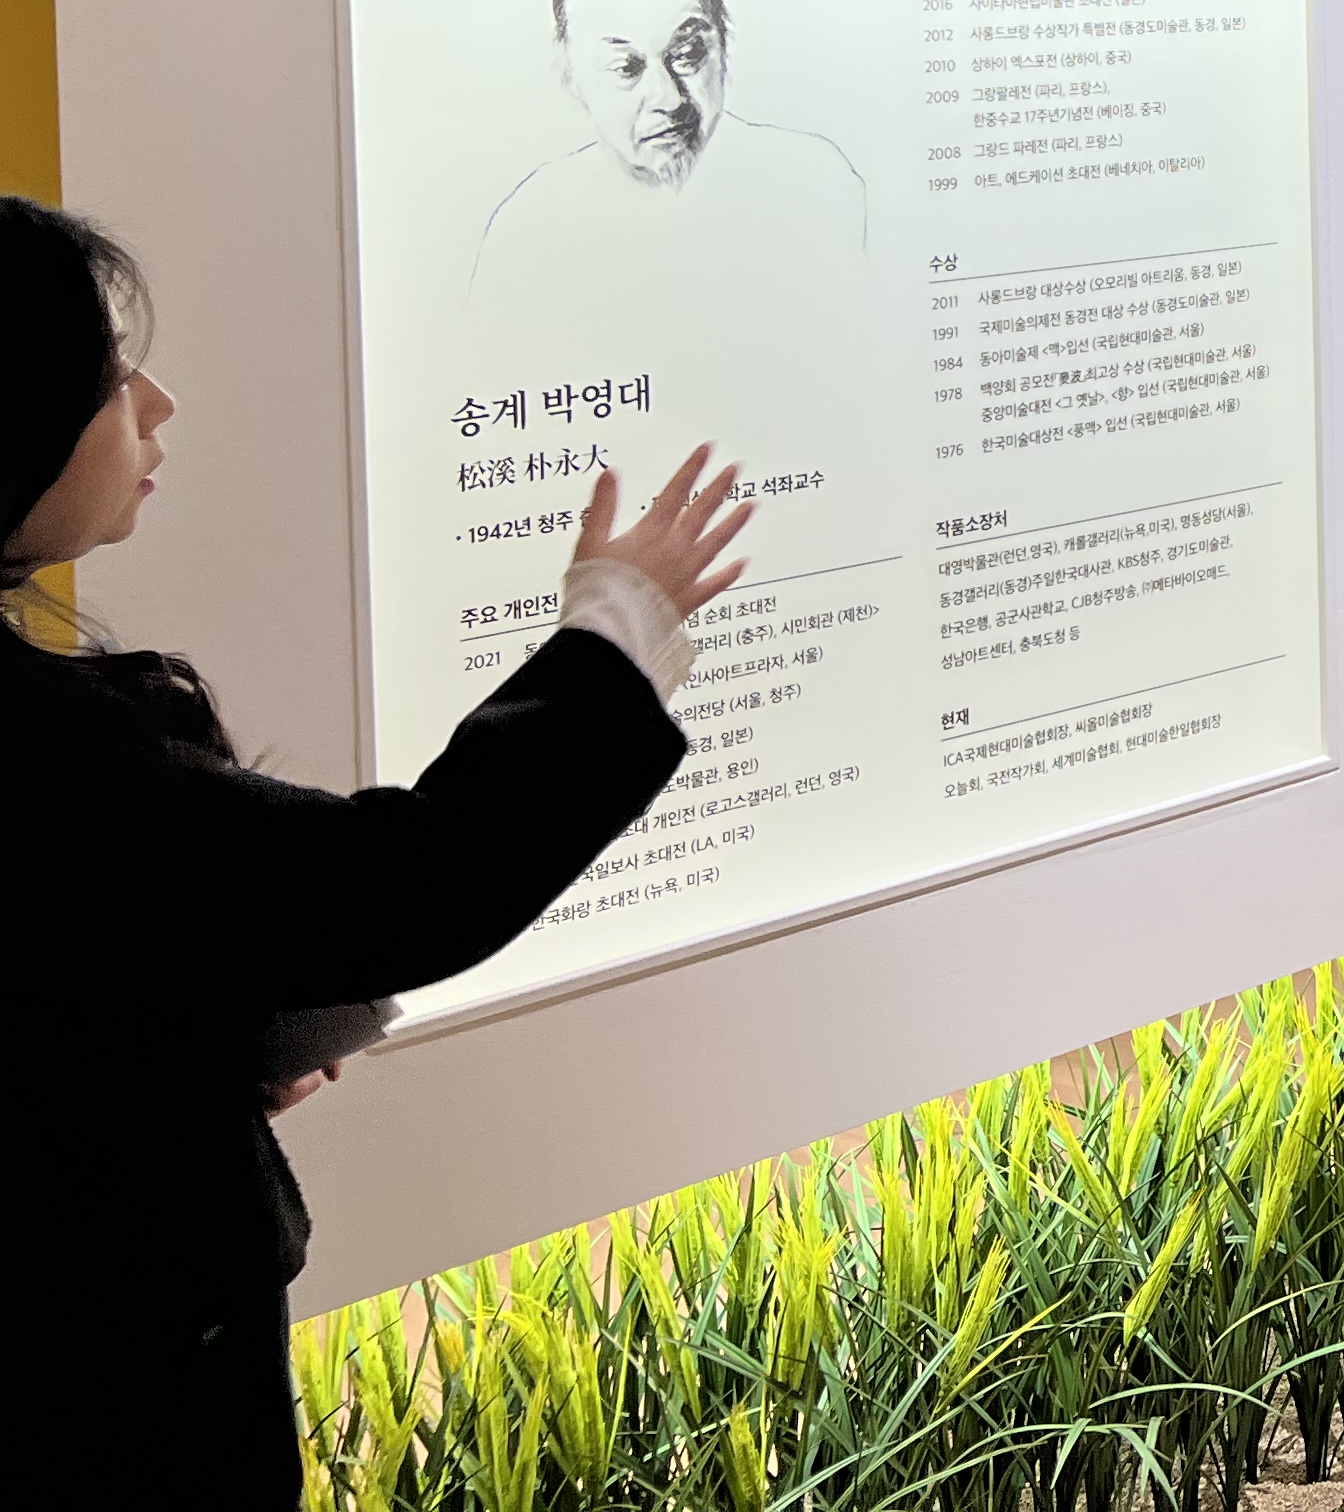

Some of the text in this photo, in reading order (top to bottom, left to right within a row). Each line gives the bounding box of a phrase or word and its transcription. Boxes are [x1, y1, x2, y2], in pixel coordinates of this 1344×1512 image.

[924, 29, 953, 42] 2012
[1033, 23, 1079, 39] 수상작가
[1082, 22, 1116, 36] 특별전
[925, 59, 955, 73] 2010
[971, 56, 1007, 72] 상하이
[1011, 53, 1057, 70] 엑스포전
[926, 90, 959, 104] 2009
[974, 112, 1021, 128] 한중수교
[1025, 106, 1093, 124] 17주년기념전
[928, 146, 961, 160] 2008
[974, 142, 1010, 157] 그랑드
[929, 177, 957, 191] 1999
[1067, 164, 1100, 179] 초대전
[930, 254, 958, 273] 수상
[932, 295, 958, 310] 2011
[1041, 279, 1086, 298] 대상수상
[933, 326, 958, 341] 1991
[978, 312, 1061, 336] 국제미술의제전
[1065, 307, 1098, 325] 동경전
[1102, 304, 1124, 319] 대상
[1127, 301, 1149, 317] 수상
[934, 356, 963, 371] 1984
[980, 345, 1038, 367] 동아미술제
[935, 388, 962, 402] 1978
[981, 378, 1016, 396] 백양회
[1123, 359, 1145, 376] 수상
[451, 374, 649, 437] 송계 박영대
[982, 398, 1051, 422] 중앙미술대전
[1138, 381, 1159, 398] 입선
[936, 444, 963, 459] 1976
[982, 426, 1063, 453] 한국미술대상전
[1106, 416, 1127, 432] 입선
[523, 443, 609, 482] 朴永大
[762, 471, 824, 495] 석좌교수
[469, 517, 531, 543] 1942년
[538, 511, 573, 533] 청주
[936, 510, 1007, 538] 작품소장처
[461, 593, 559, 628] 주요 개인전
[704, 596, 776, 625] 순회 초대전
[781, 612, 834, 635] 시민회관
[1020, 628, 1065, 652] 충북도청
[1069, 625, 1080, 641] 등
[465, 651, 500, 671] 2021
[942, 708, 969, 730] 현재
[653, 805, 695, 829] 개인전
[644, 841, 686, 866] 초대전
[596, 887, 639, 912] 초대전
